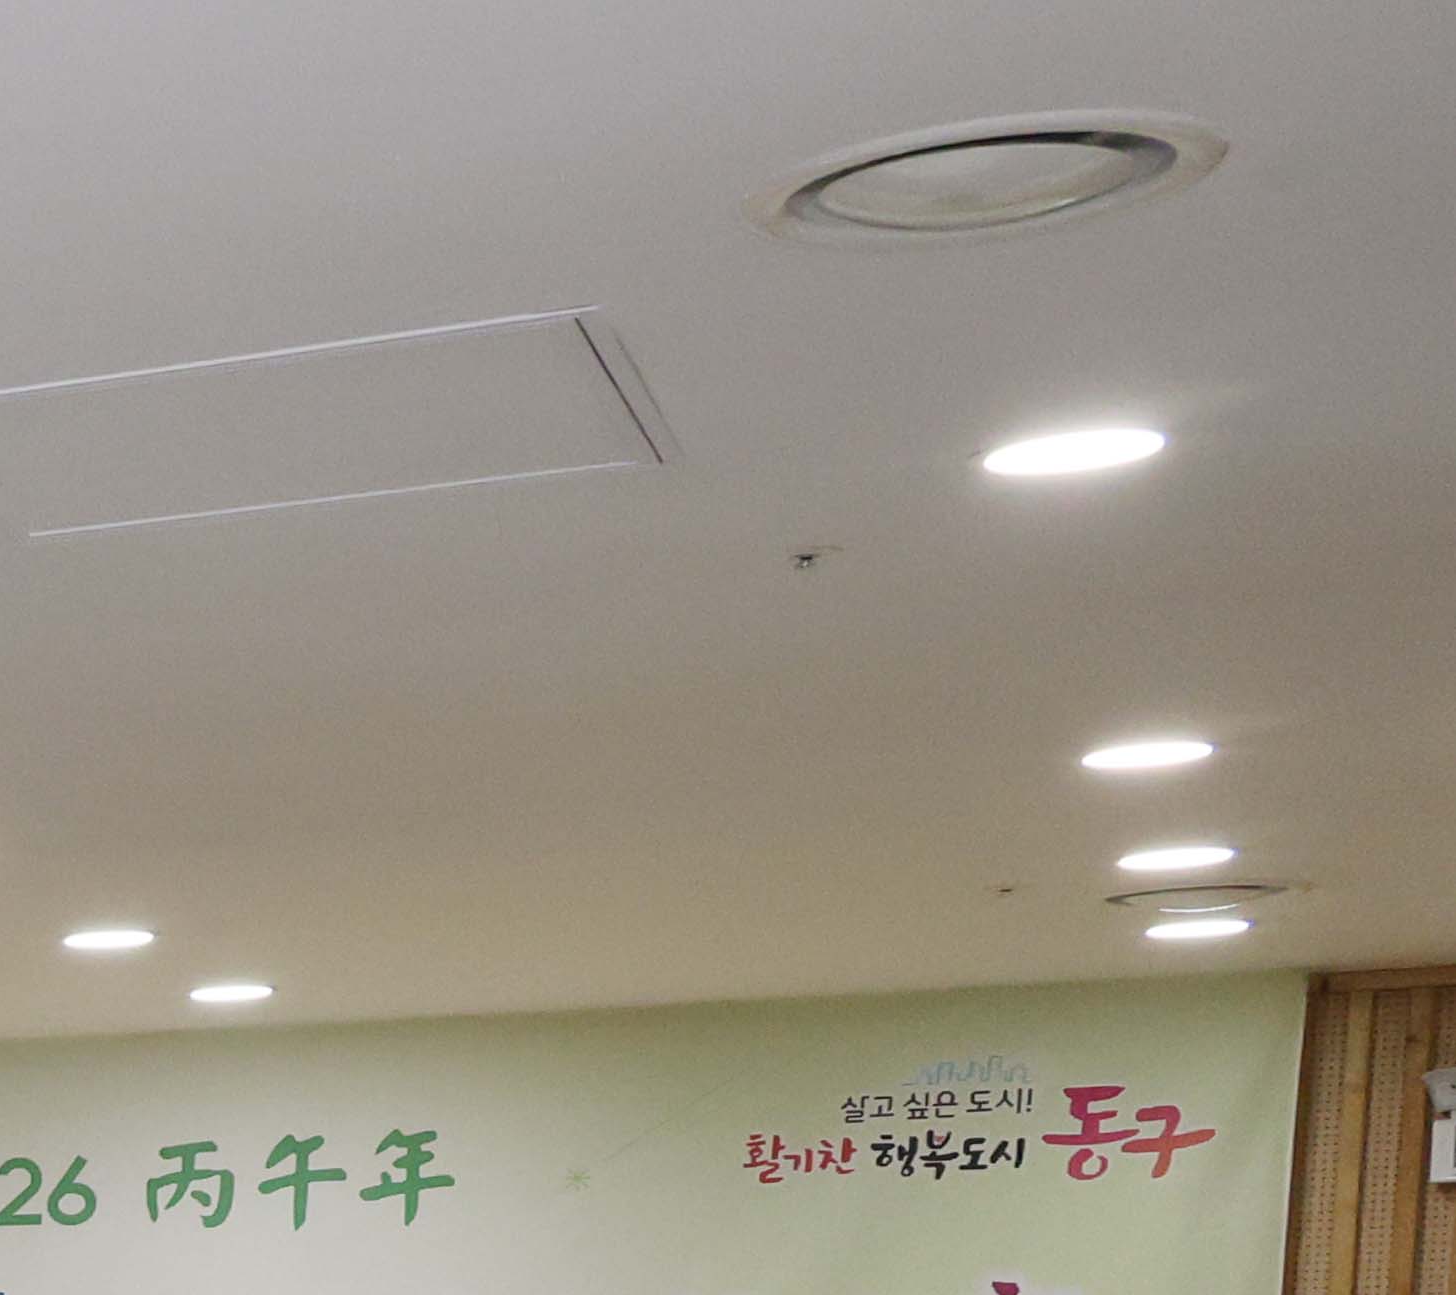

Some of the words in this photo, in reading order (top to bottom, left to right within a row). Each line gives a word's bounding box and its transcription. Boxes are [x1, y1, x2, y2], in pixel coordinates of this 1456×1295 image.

[742, 1132, 858, 1184] 활기찬
[870, 1129, 1027, 1180] 행복도시
[1040, 1084, 1217, 1181] 동구
[840, 1094, 896, 1124] 살고
[903, 1091, 958, 1120] 싶은
[966, 1088, 1034, 1115] 도시!
[145, 1129, 456, 1230] 丙午年
